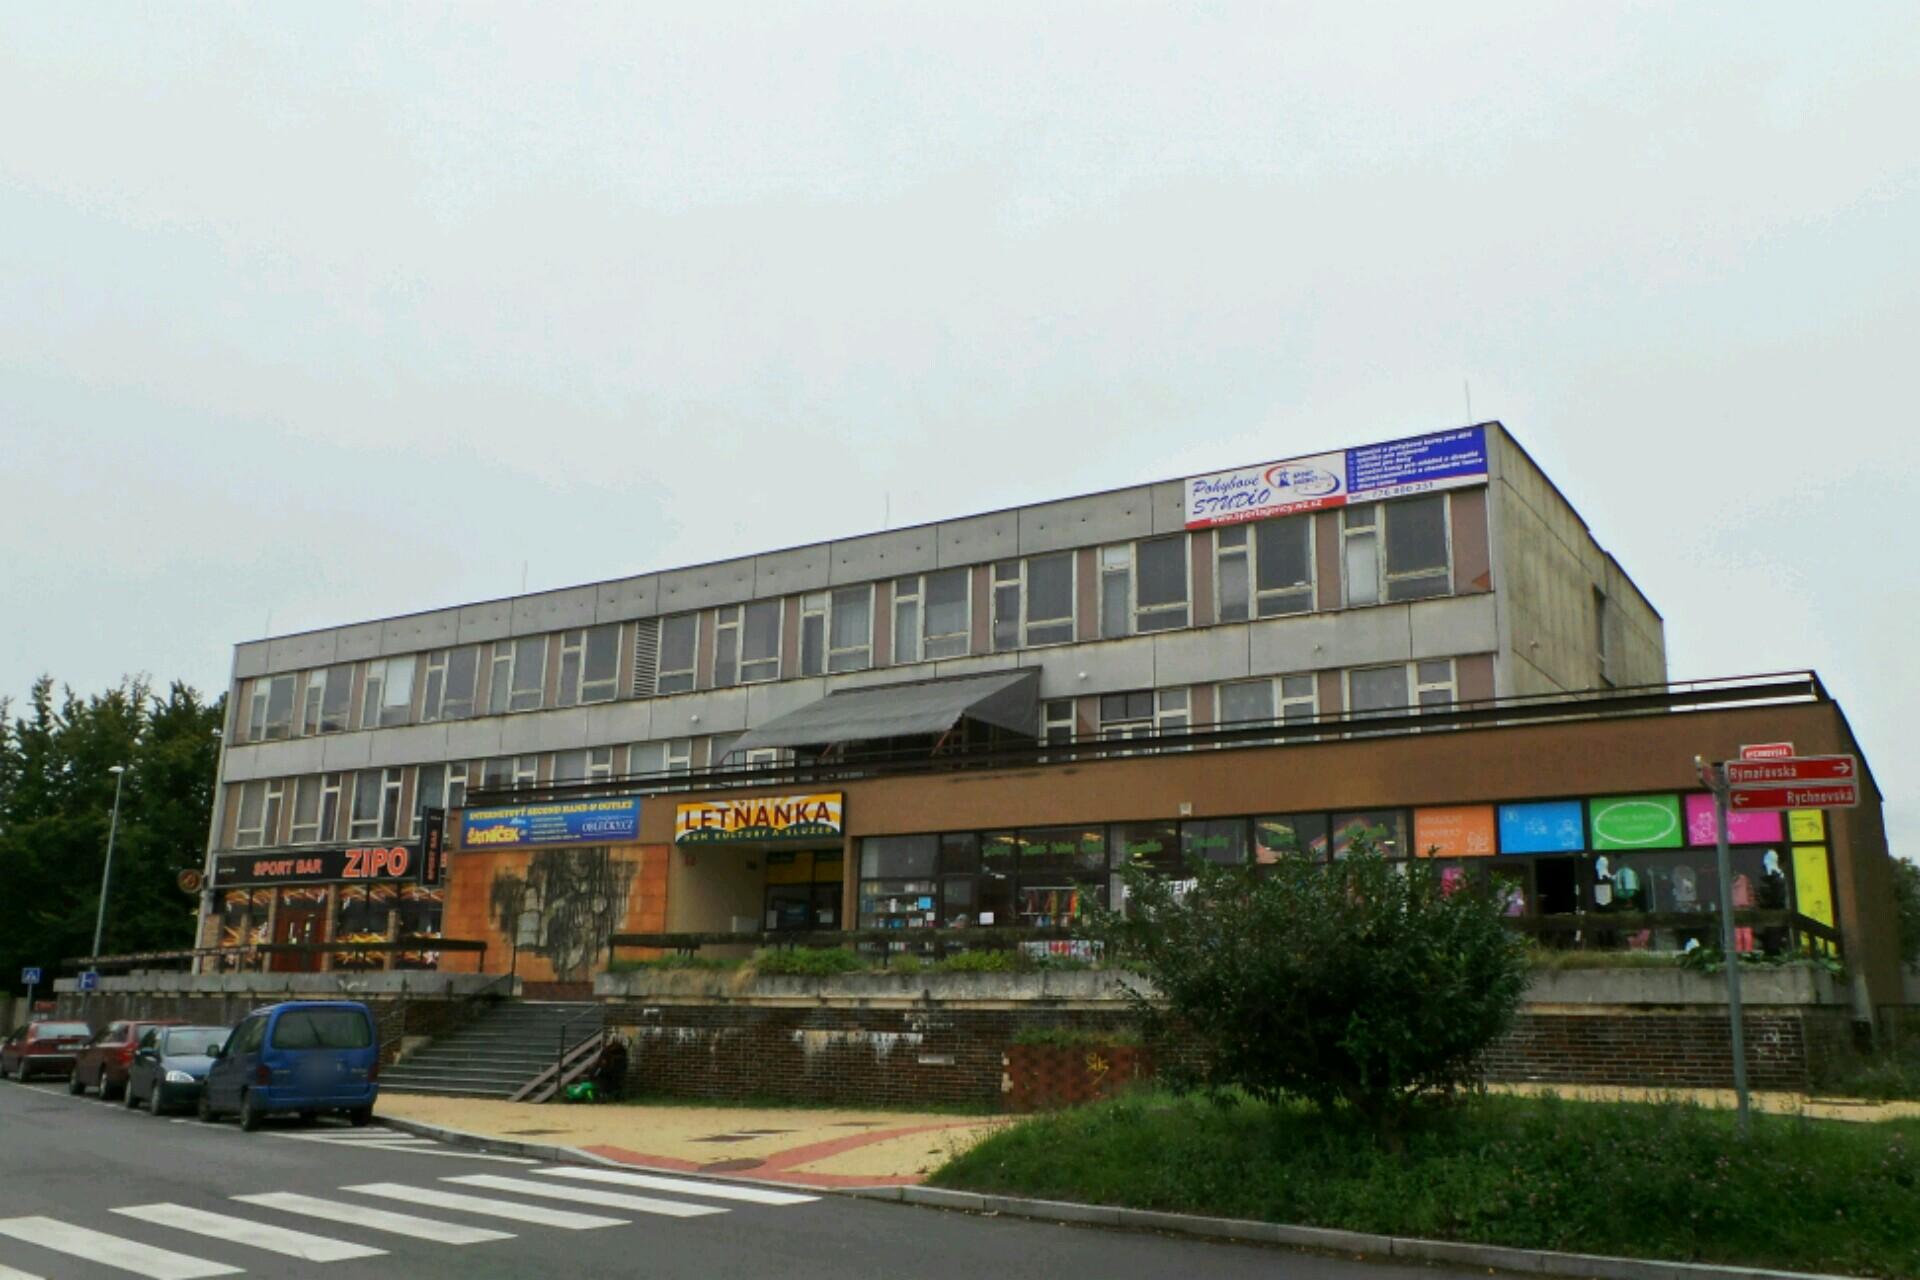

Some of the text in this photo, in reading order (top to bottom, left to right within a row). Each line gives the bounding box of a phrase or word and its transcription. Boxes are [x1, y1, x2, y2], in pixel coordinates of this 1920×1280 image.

[1193, 474, 1259, 497] Pohybové
[1729, 765, 1797, 783] Rýmařovská
[1787, 790, 1852, 808] Rychnovská
[684, 801, 831, 830] LETŇANKA
[253, 860, 295, 876] SPORT
[296, 858, 322, 875] BAR
[342, 847, 409, 878] ZIPO
